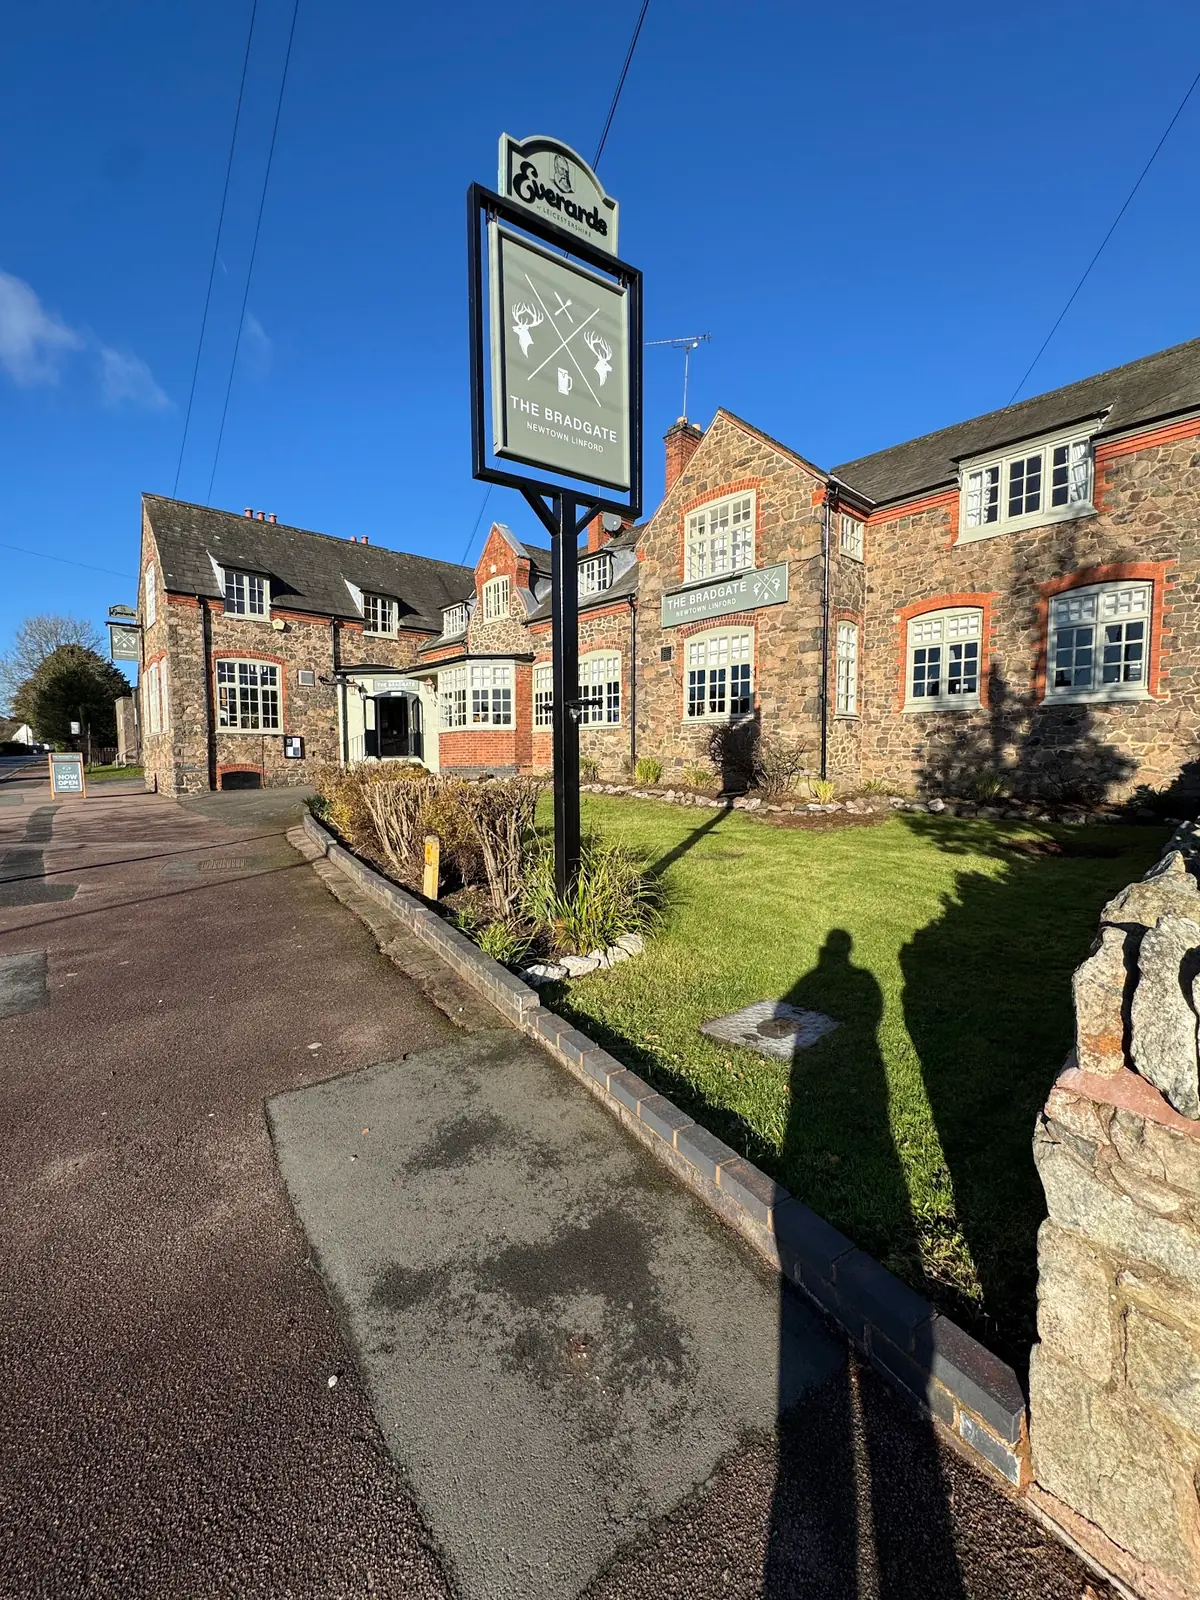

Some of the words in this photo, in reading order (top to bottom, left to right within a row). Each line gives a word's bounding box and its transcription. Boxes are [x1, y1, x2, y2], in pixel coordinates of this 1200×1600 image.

[513, 161, 608, 237] Everards
[543, 208, 591, 238] LEICESTERSHIRE
[510, 395, 540, 417] THE
[544, 407, 617, 443] BRADGATE
[526, 421, 569, 442] NEWTOWN
[571, 436, 604, 453] LINFORD
[668, 597, 686, 610] THE
[690, 581, 747, 604] BRADGATE
[676, 605, 706, 618] NEWTOWN
[708, 598, 737, 610] LINFORD
